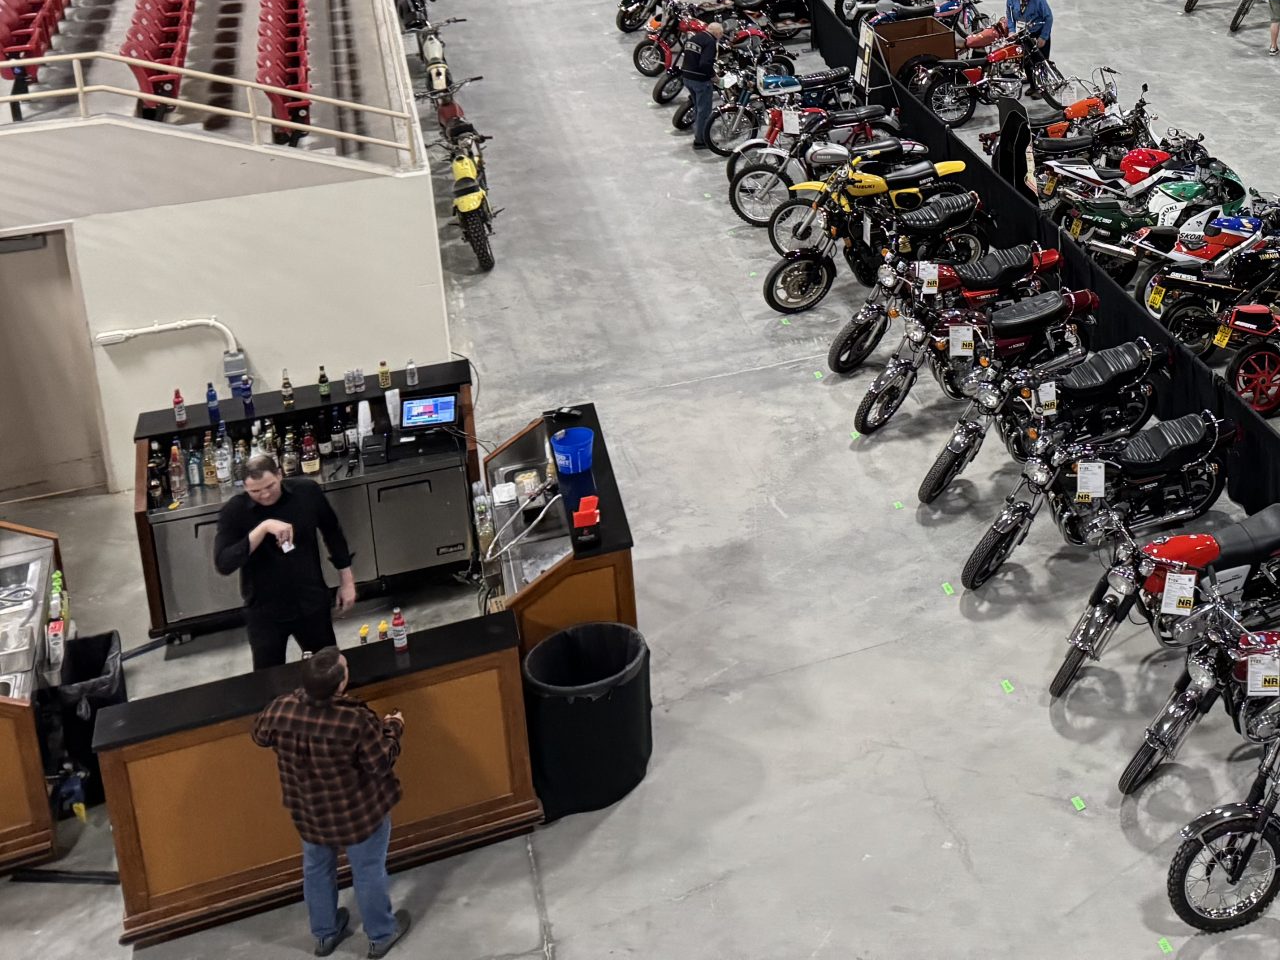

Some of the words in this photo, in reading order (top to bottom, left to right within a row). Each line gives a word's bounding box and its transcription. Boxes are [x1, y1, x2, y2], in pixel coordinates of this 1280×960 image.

[1259, 252, 1280, 261] YAMAHA
[1077, 493, 1090, 501] NR
[1178, 599, 1191, 607] NR
[1264, 677, 1278, 685] NR
